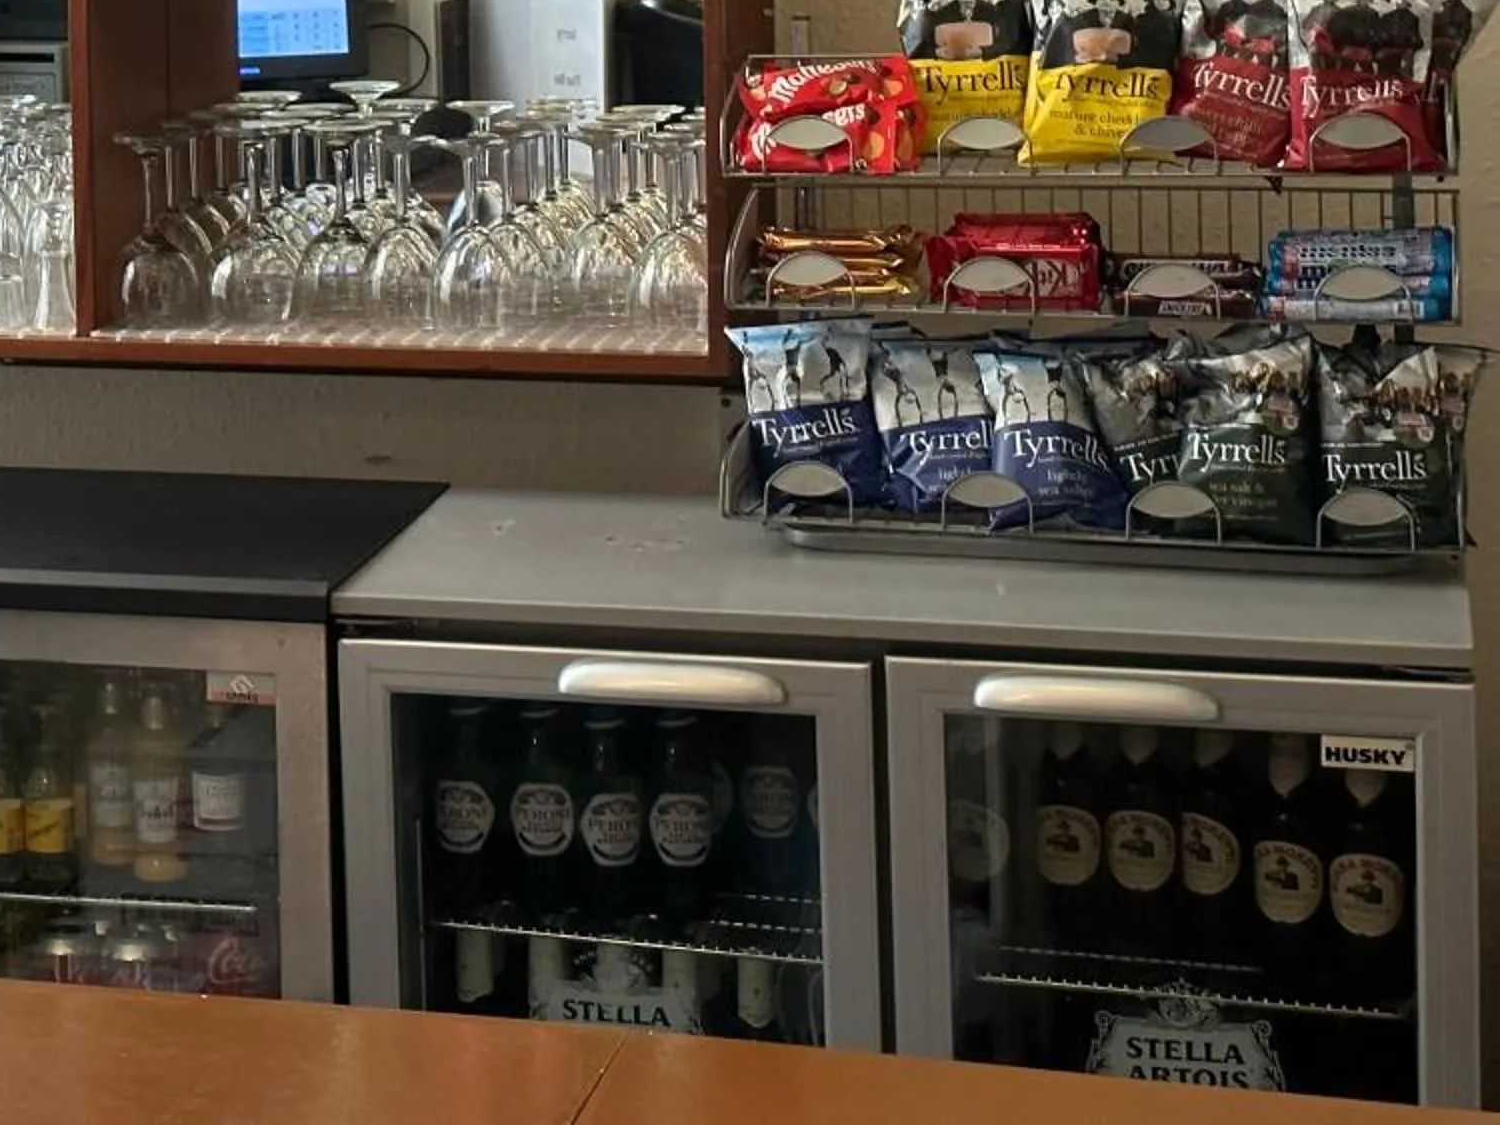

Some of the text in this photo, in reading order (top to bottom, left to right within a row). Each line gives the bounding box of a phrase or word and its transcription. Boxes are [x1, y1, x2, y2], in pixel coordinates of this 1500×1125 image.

[1324, 746, 1406, 767] HUSKY
[562, 998, 672, 1027] STELLA
[1125, 1036, 1246, 1065] STELLA
